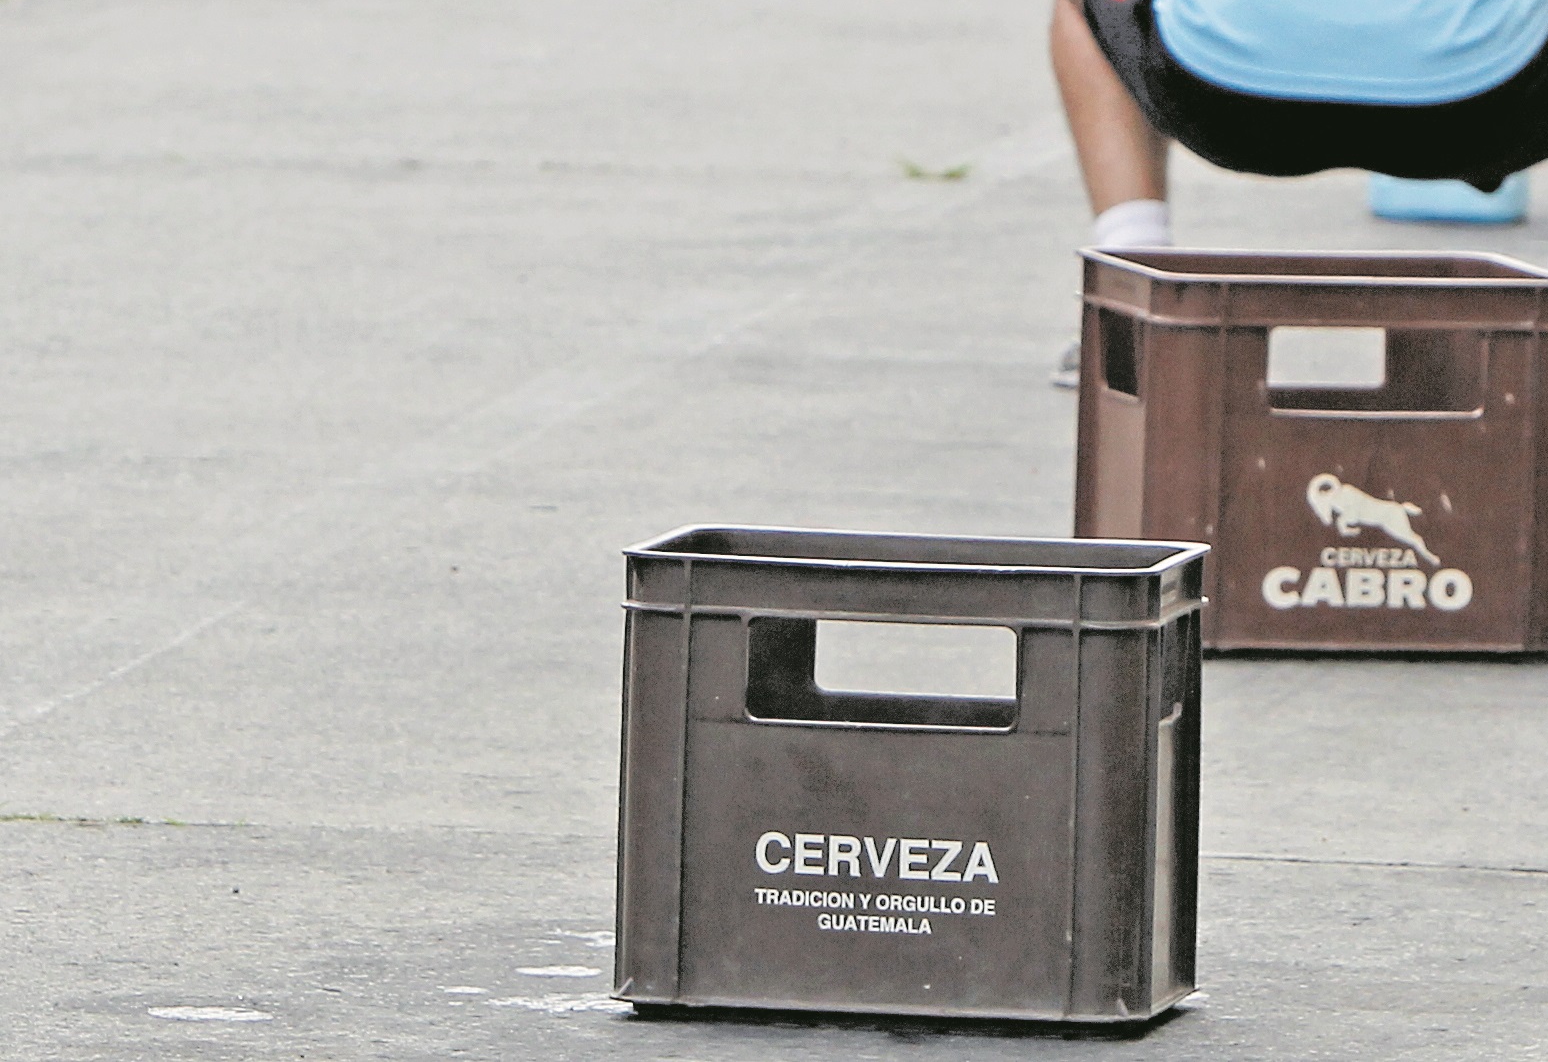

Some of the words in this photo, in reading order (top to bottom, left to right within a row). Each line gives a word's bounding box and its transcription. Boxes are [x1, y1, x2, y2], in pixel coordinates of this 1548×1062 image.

[1320, 546, 1418, 568] CERVEZA
[1262, 566, 1474, 611] CABRO
[755, 831, 999, 884] CERVEZA
[754, 888, 855, 909] TRADICION
[858, 893, 873, 911] Y
[875, 893, 966, 914] ORGULLO
[970, 899, 997, 916] DE
[817, 913, 933, 935] GUATEMALA
